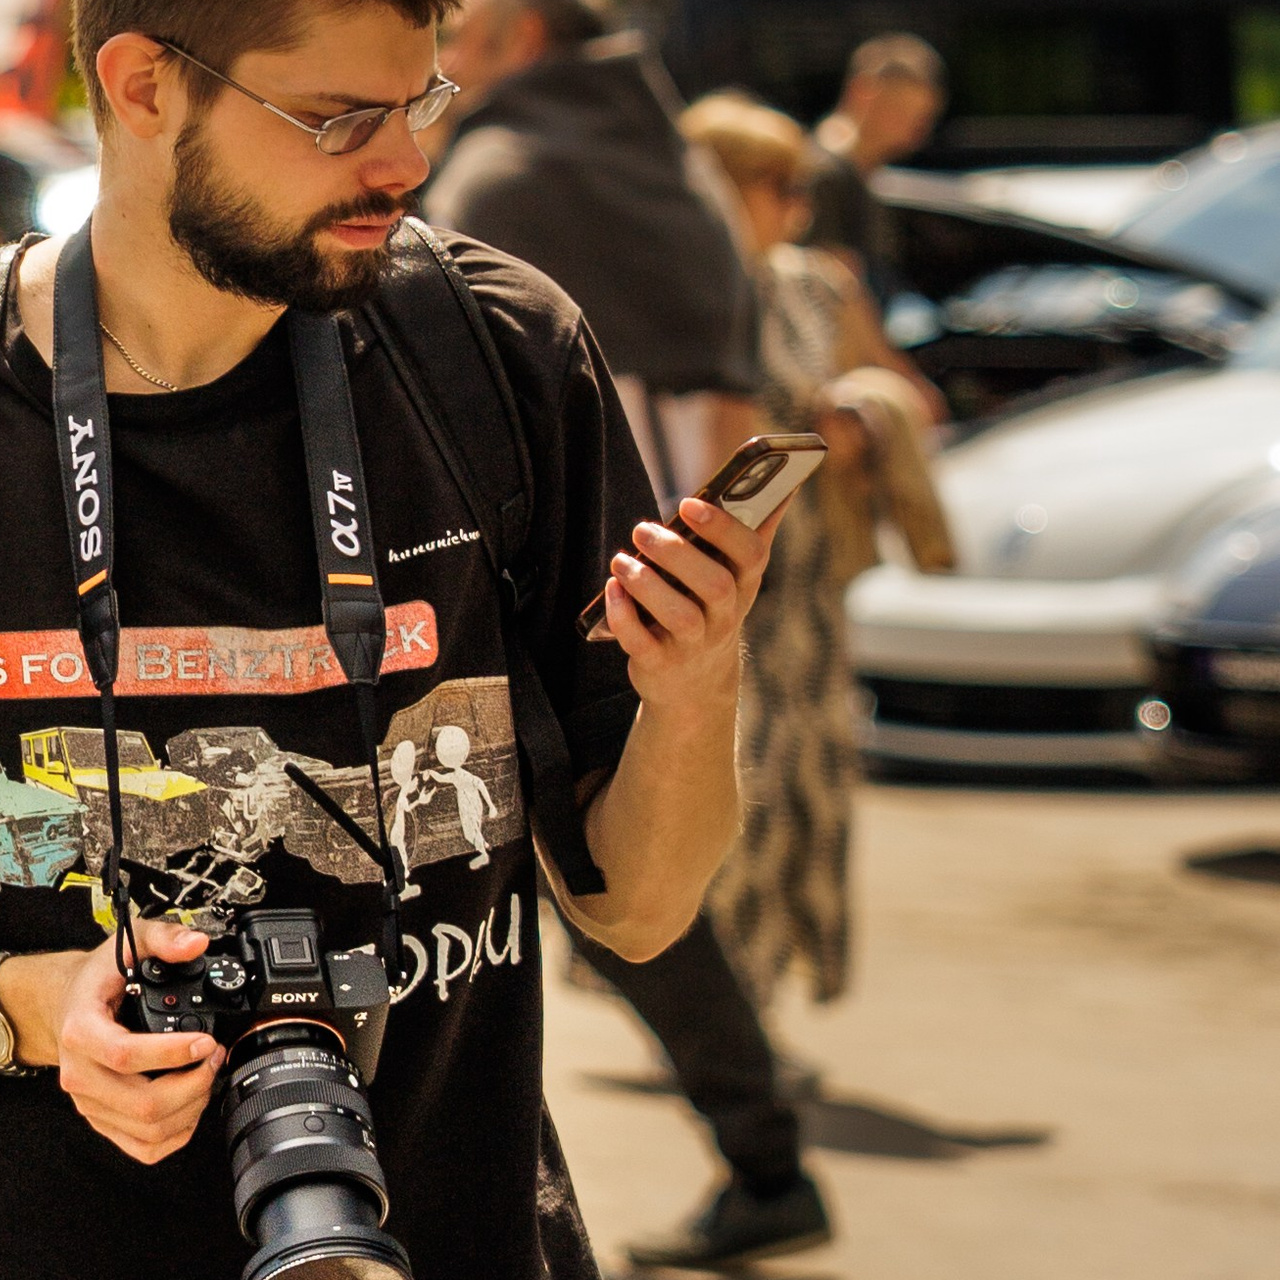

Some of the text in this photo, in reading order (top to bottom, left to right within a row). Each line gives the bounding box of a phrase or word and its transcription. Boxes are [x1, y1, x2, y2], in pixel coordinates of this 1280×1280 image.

[68, 415, 102, 562] SONY
[21, 651, 100, 686] FO
[271, 992, 319, 1004] SONY
